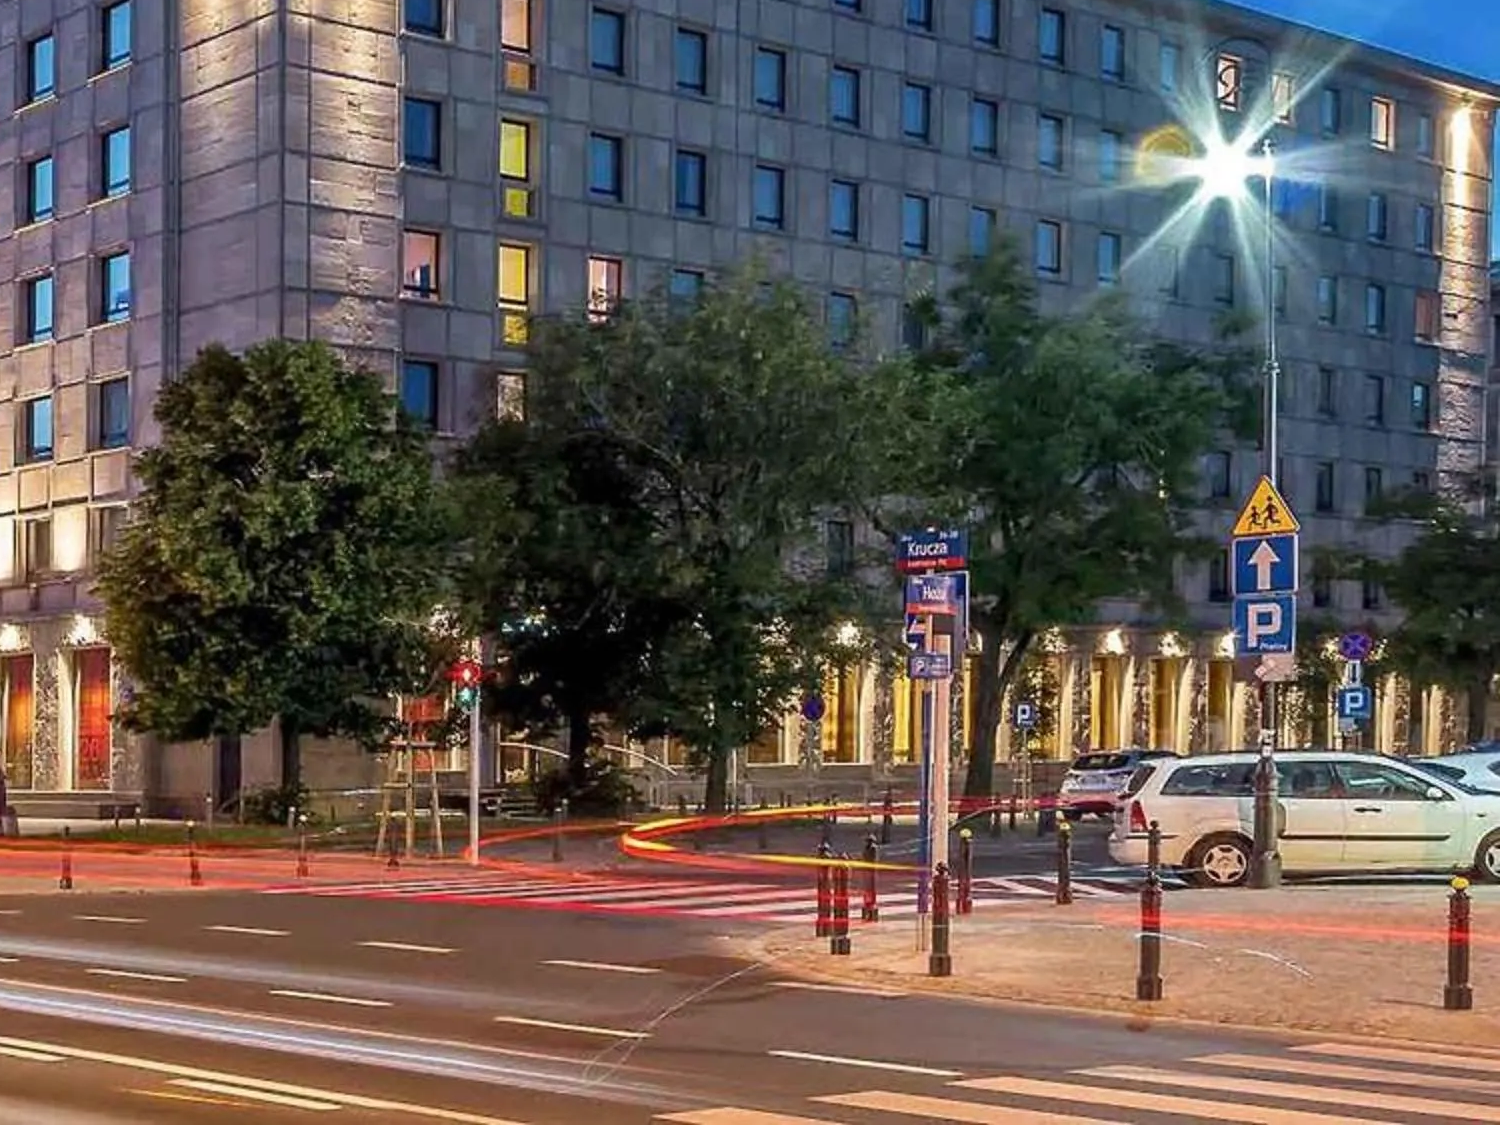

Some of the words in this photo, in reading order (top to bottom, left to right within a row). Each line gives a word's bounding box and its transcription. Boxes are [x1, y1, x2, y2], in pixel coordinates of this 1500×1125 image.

[907, 541, 949, 556] Krucza
[1247, 603, 1282, 648] P
[1017, 704, 1031, 725] P
[1345, 692, 1364, 715] P
